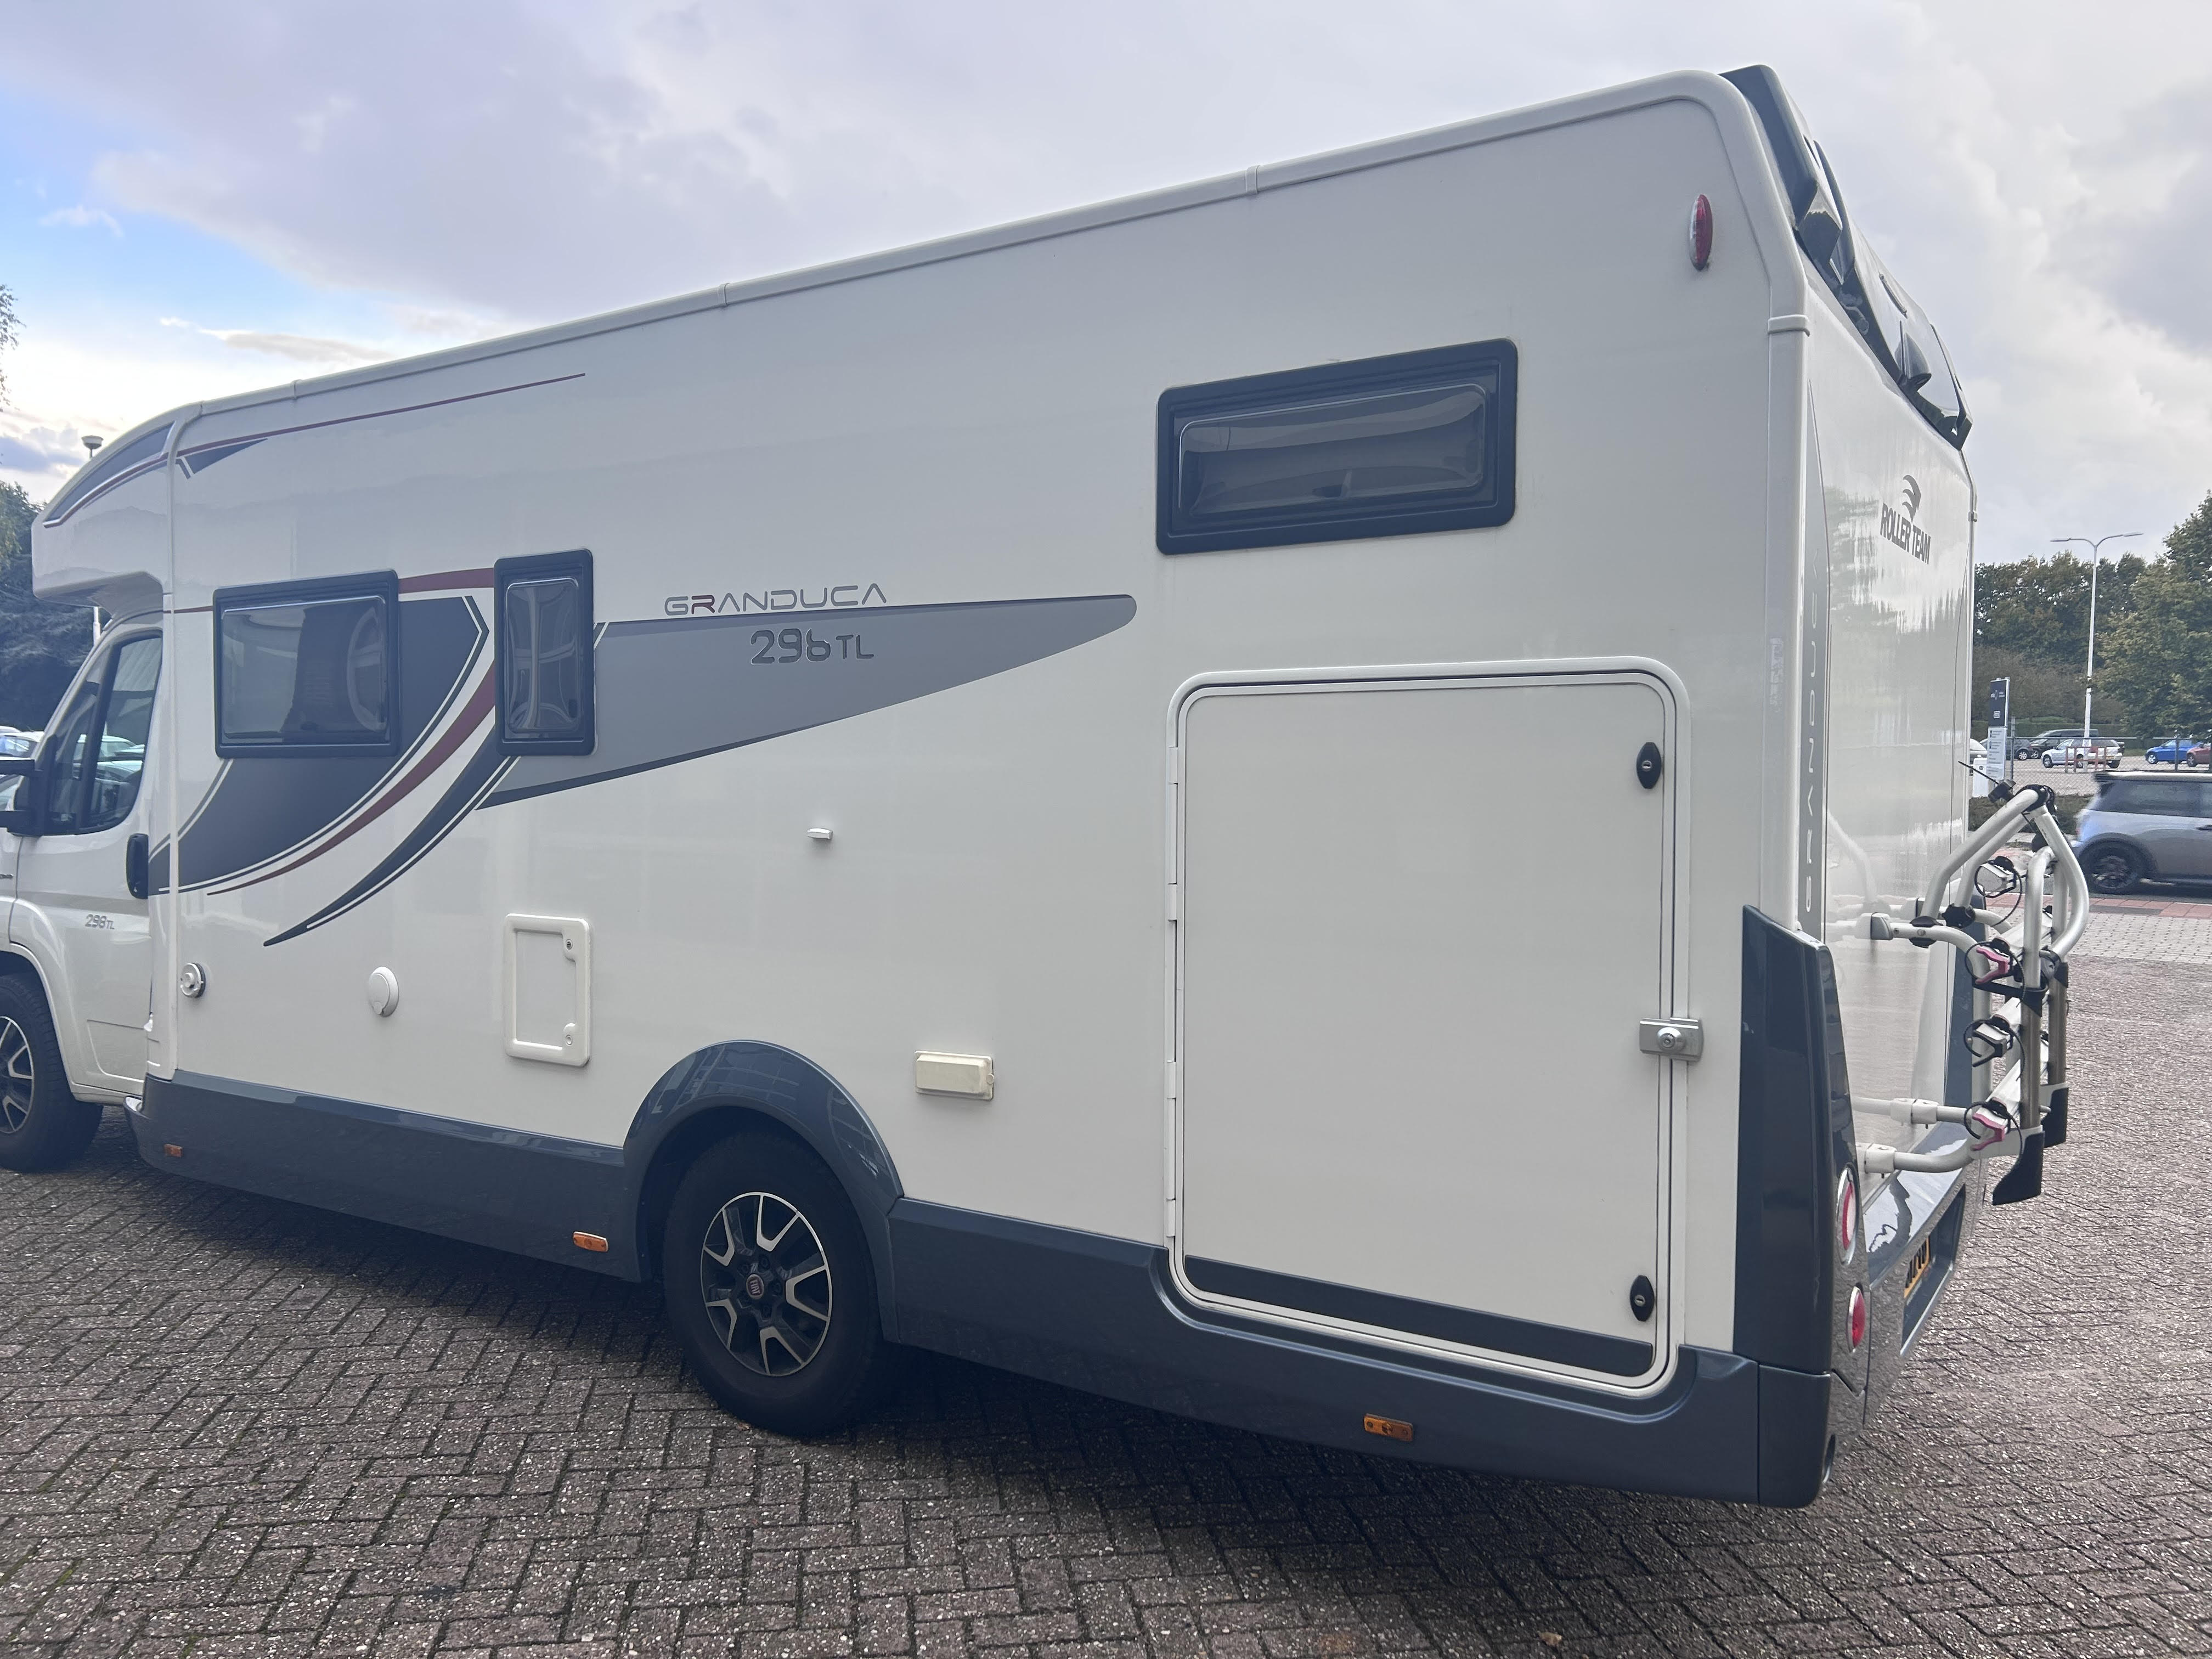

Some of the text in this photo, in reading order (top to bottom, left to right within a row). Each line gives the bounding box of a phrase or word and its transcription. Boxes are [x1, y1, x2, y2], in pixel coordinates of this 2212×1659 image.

[1880, 503, 1931, 565] ROLLER TEAM
[664, 583, 887, 616] GRANDUCA
[1806, 549, 1818, 913] GRANDUCA
[749, 1280, 760, 1294] FIAT
